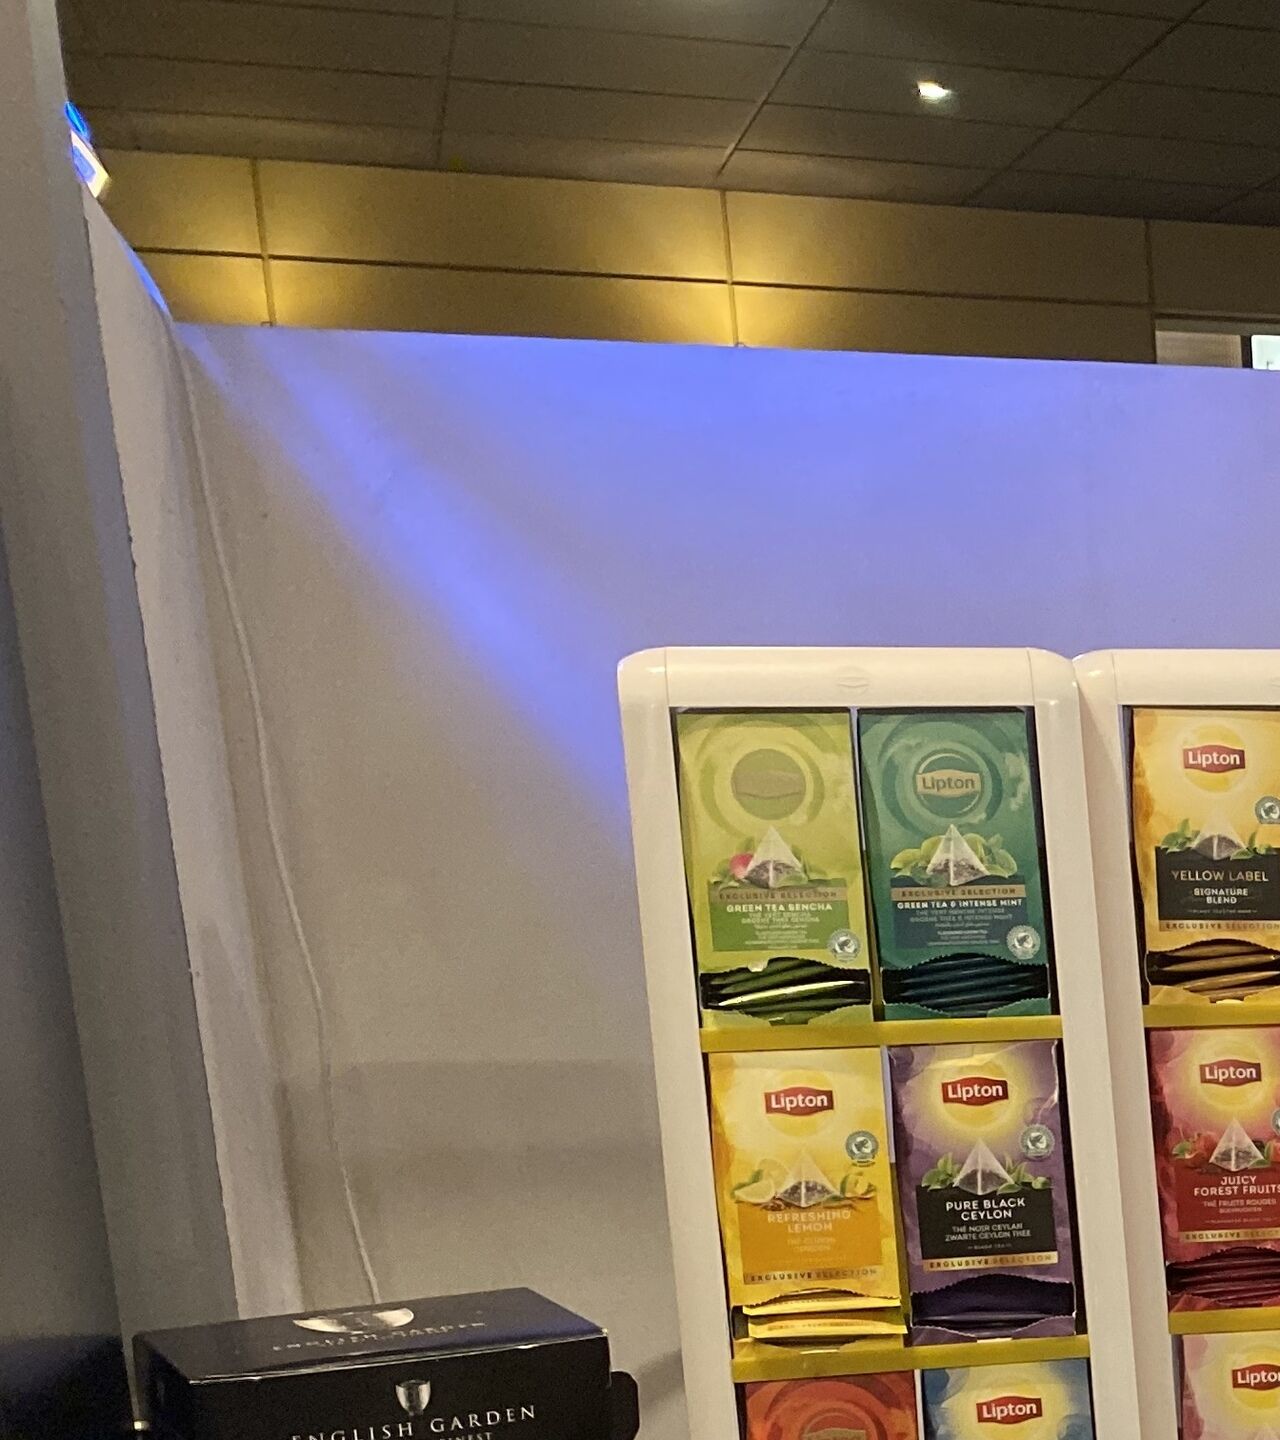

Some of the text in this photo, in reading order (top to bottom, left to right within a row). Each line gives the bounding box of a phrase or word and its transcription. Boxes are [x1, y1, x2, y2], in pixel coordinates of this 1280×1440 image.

[1188, 750, 1240, 768] Lipton
[922, 776, 975, 792] Lipton
[1171, 870, 1269, 882] YELLOW LABEL
[902, 888, 1016, 897] EXCLUSIVE SELECTION
[1194, 888, 1249, 896] SIGNATURE
[931, 901, 948, 909] TEA
[959, 900, 998, 908] INTENSE
[1206, 896, 1237, 904] BLEND
[726, 903, 832, 913] GREEN TEA SENCHA
[1205, 1065, 1257, 1082] Lipton
[947, 1083, 1003, 1101] Lipton
[770, 1093, 828, 1111] Lipton
[1220, 1175, 1257, 1186] JUICY
[1194, 1186, 1239, 1197] FOREST
[946, 1198, 1026, 1211] PURE BLACK
[767, 1210, 851, 1224] REFRESHING
[961, 1209, 1012, 1221] CEYLON
[788, 1223, 833, 1233] LEMON
[1185, 1231, 1241, 1240] EXCLUSIVE
[930, 1259, 989, 1268] EXCLUSIVE
[751, 1273, 812, 1282] EXCLUSIVE
[982, 1403, 1037, 1420] Lipton
[430, 1405, 536, 1432] GARDEN
